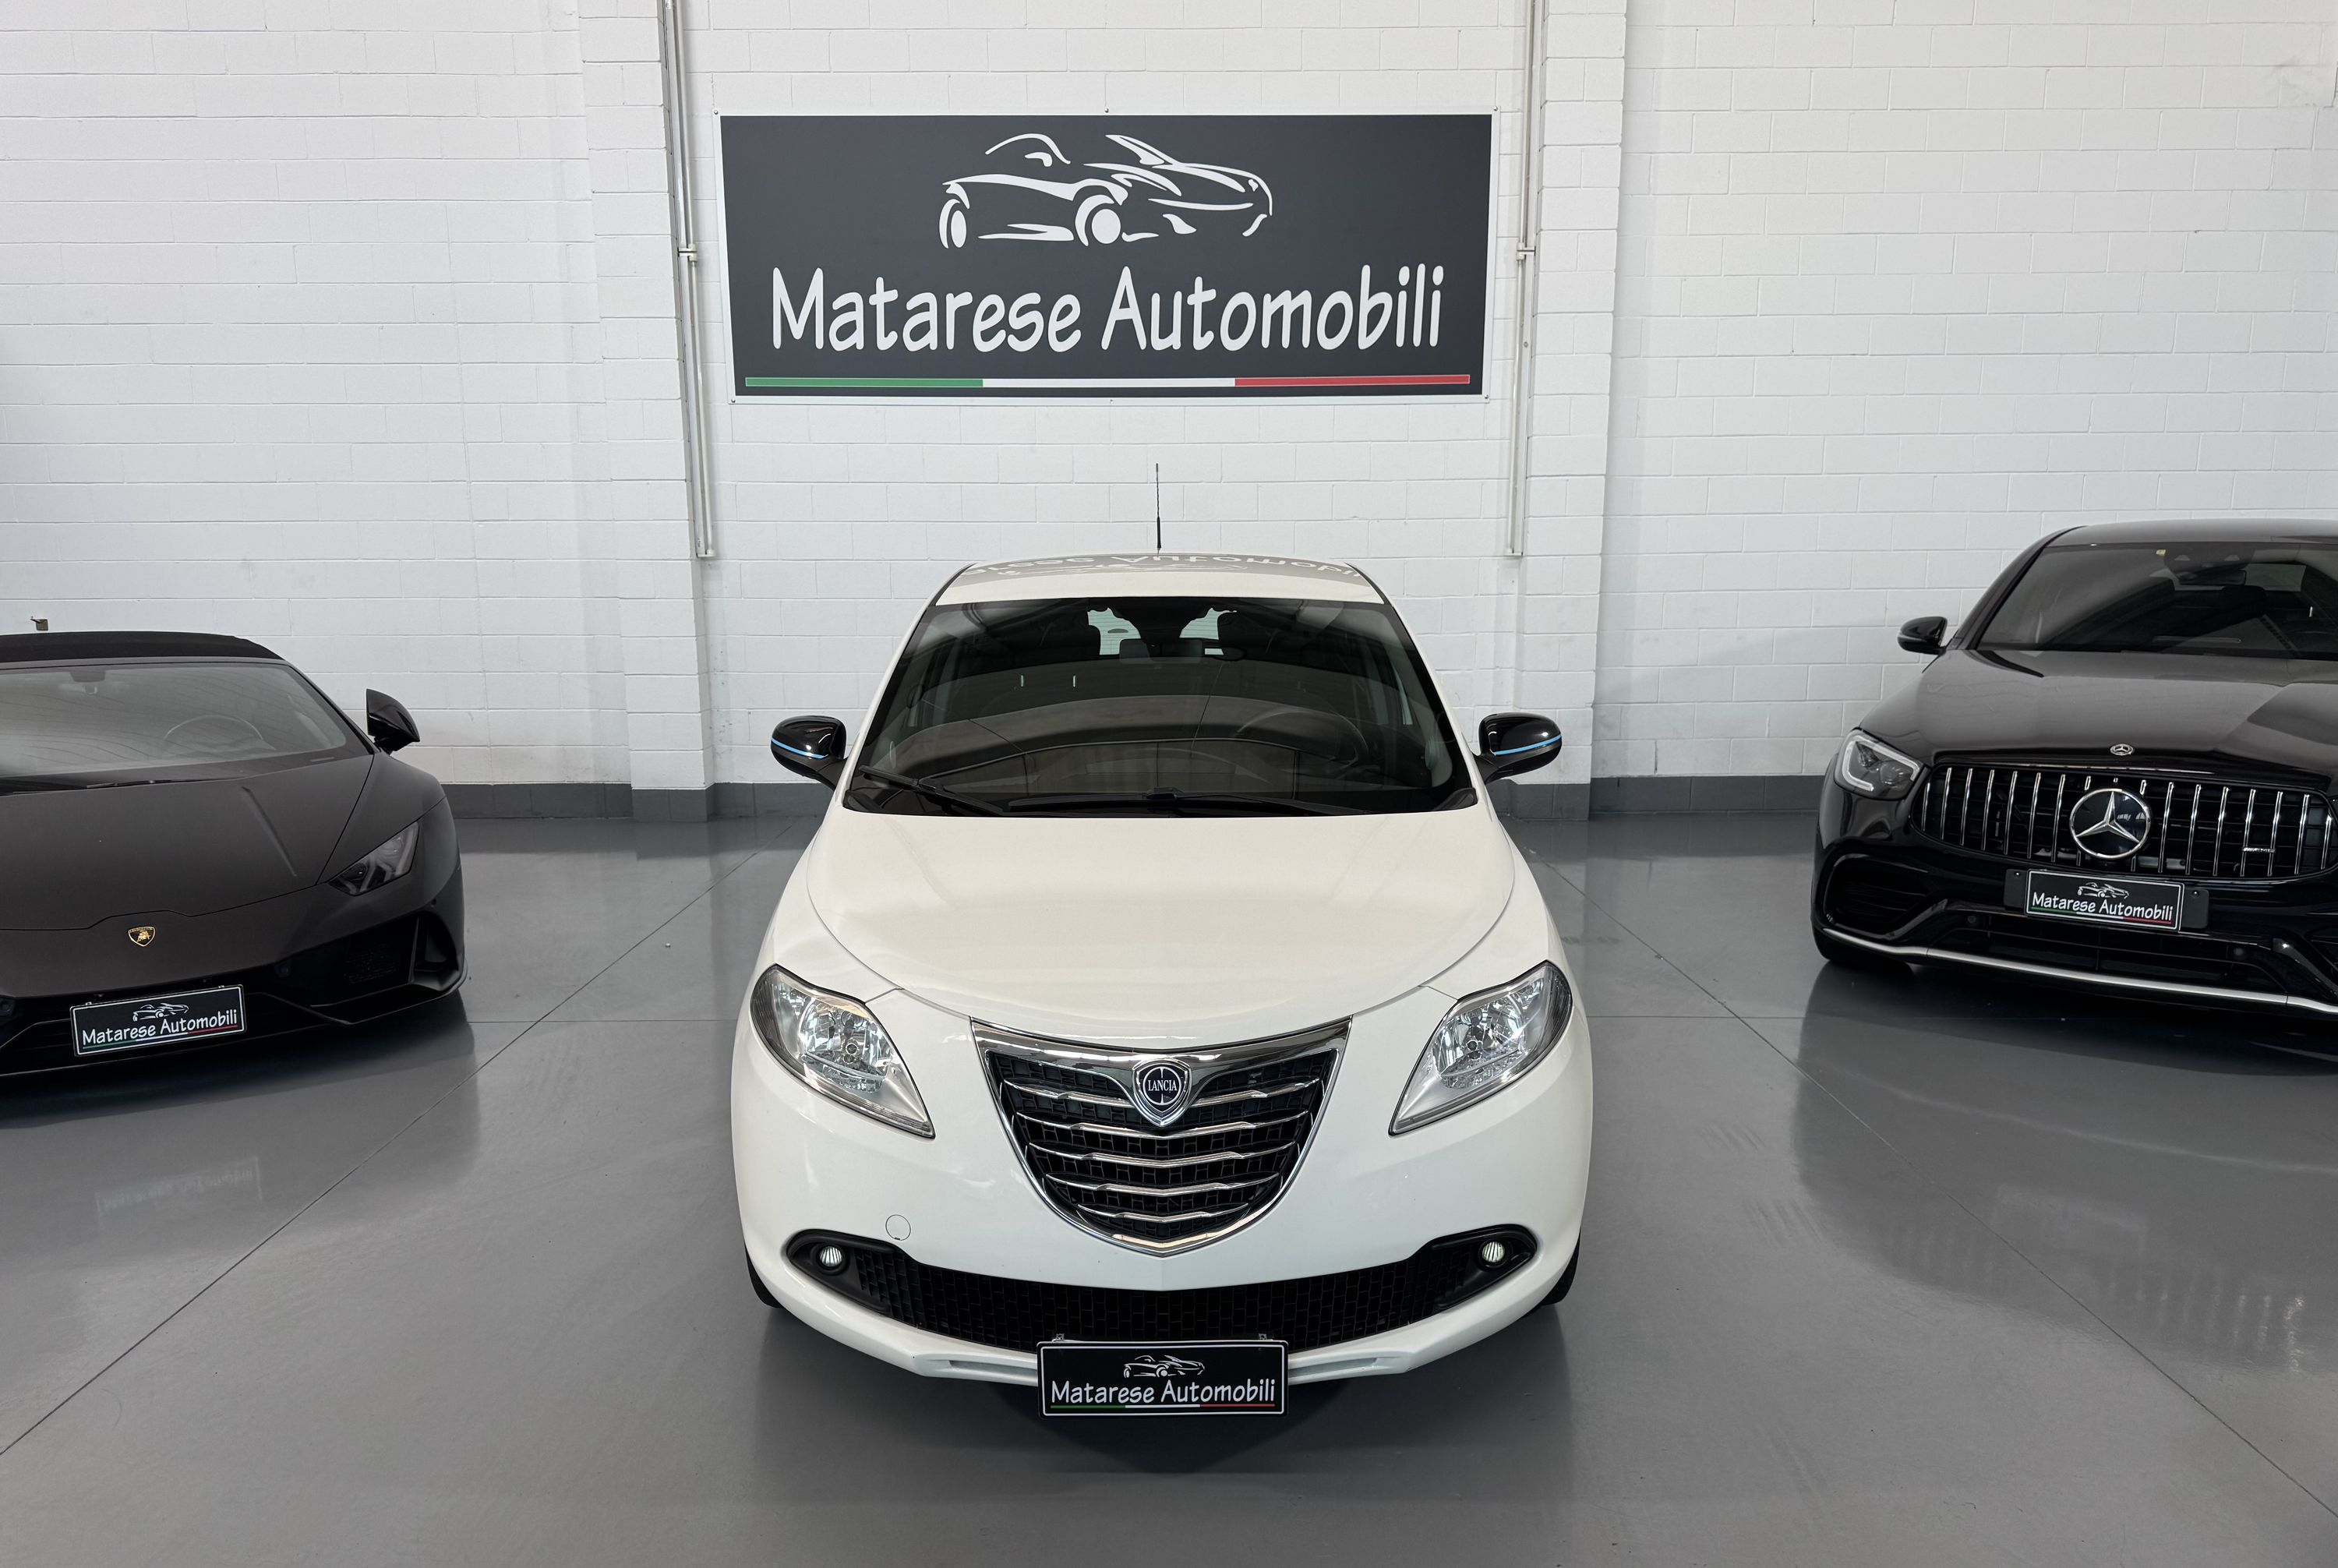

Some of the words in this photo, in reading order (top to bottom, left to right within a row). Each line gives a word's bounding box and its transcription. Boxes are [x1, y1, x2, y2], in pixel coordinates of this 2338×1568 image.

[773, 267, 1082, 352] Matarese
[1101, 263, 1444, 351] Automobili
[2032, 892, 2096, 913] Matarese
[2099, 899, 2174, 921] Automobili
[82, 1025, 157, 1046] Matarese
[160, 1008, 237, 1035] Automobili
[1147, 1079, 1178, 1091] LANCIA
[1051, 1380, 1155, 1404] Matarese
[1160, 1378, 1275, 1403] Automobili
